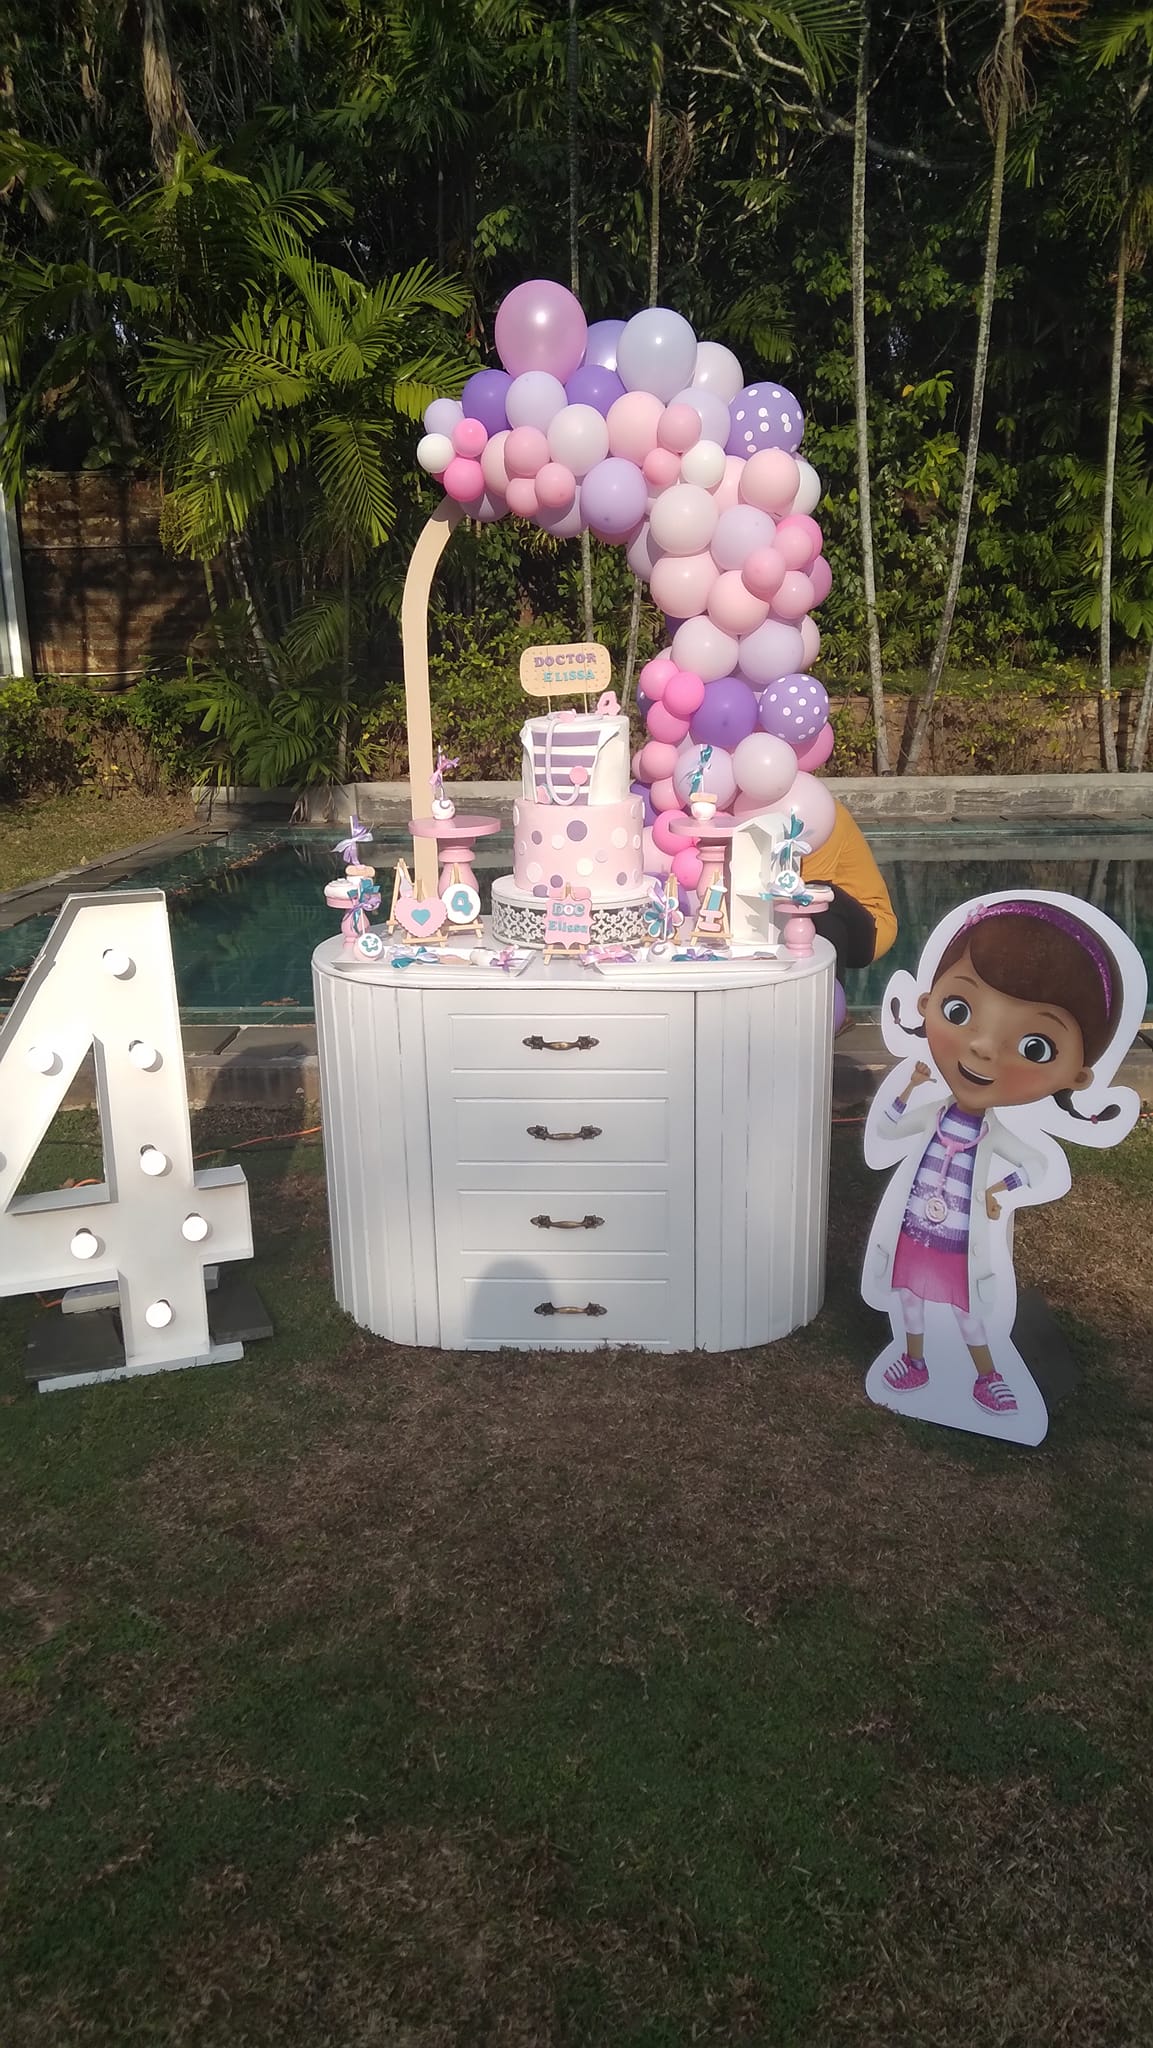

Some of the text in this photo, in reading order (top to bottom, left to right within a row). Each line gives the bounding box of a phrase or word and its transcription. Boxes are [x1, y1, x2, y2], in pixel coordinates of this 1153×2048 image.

[534, 653, 597, 667] DOCTOR
[543, 670, 595, 682] ELISSA
[0, 889, 253, 1362] 4
